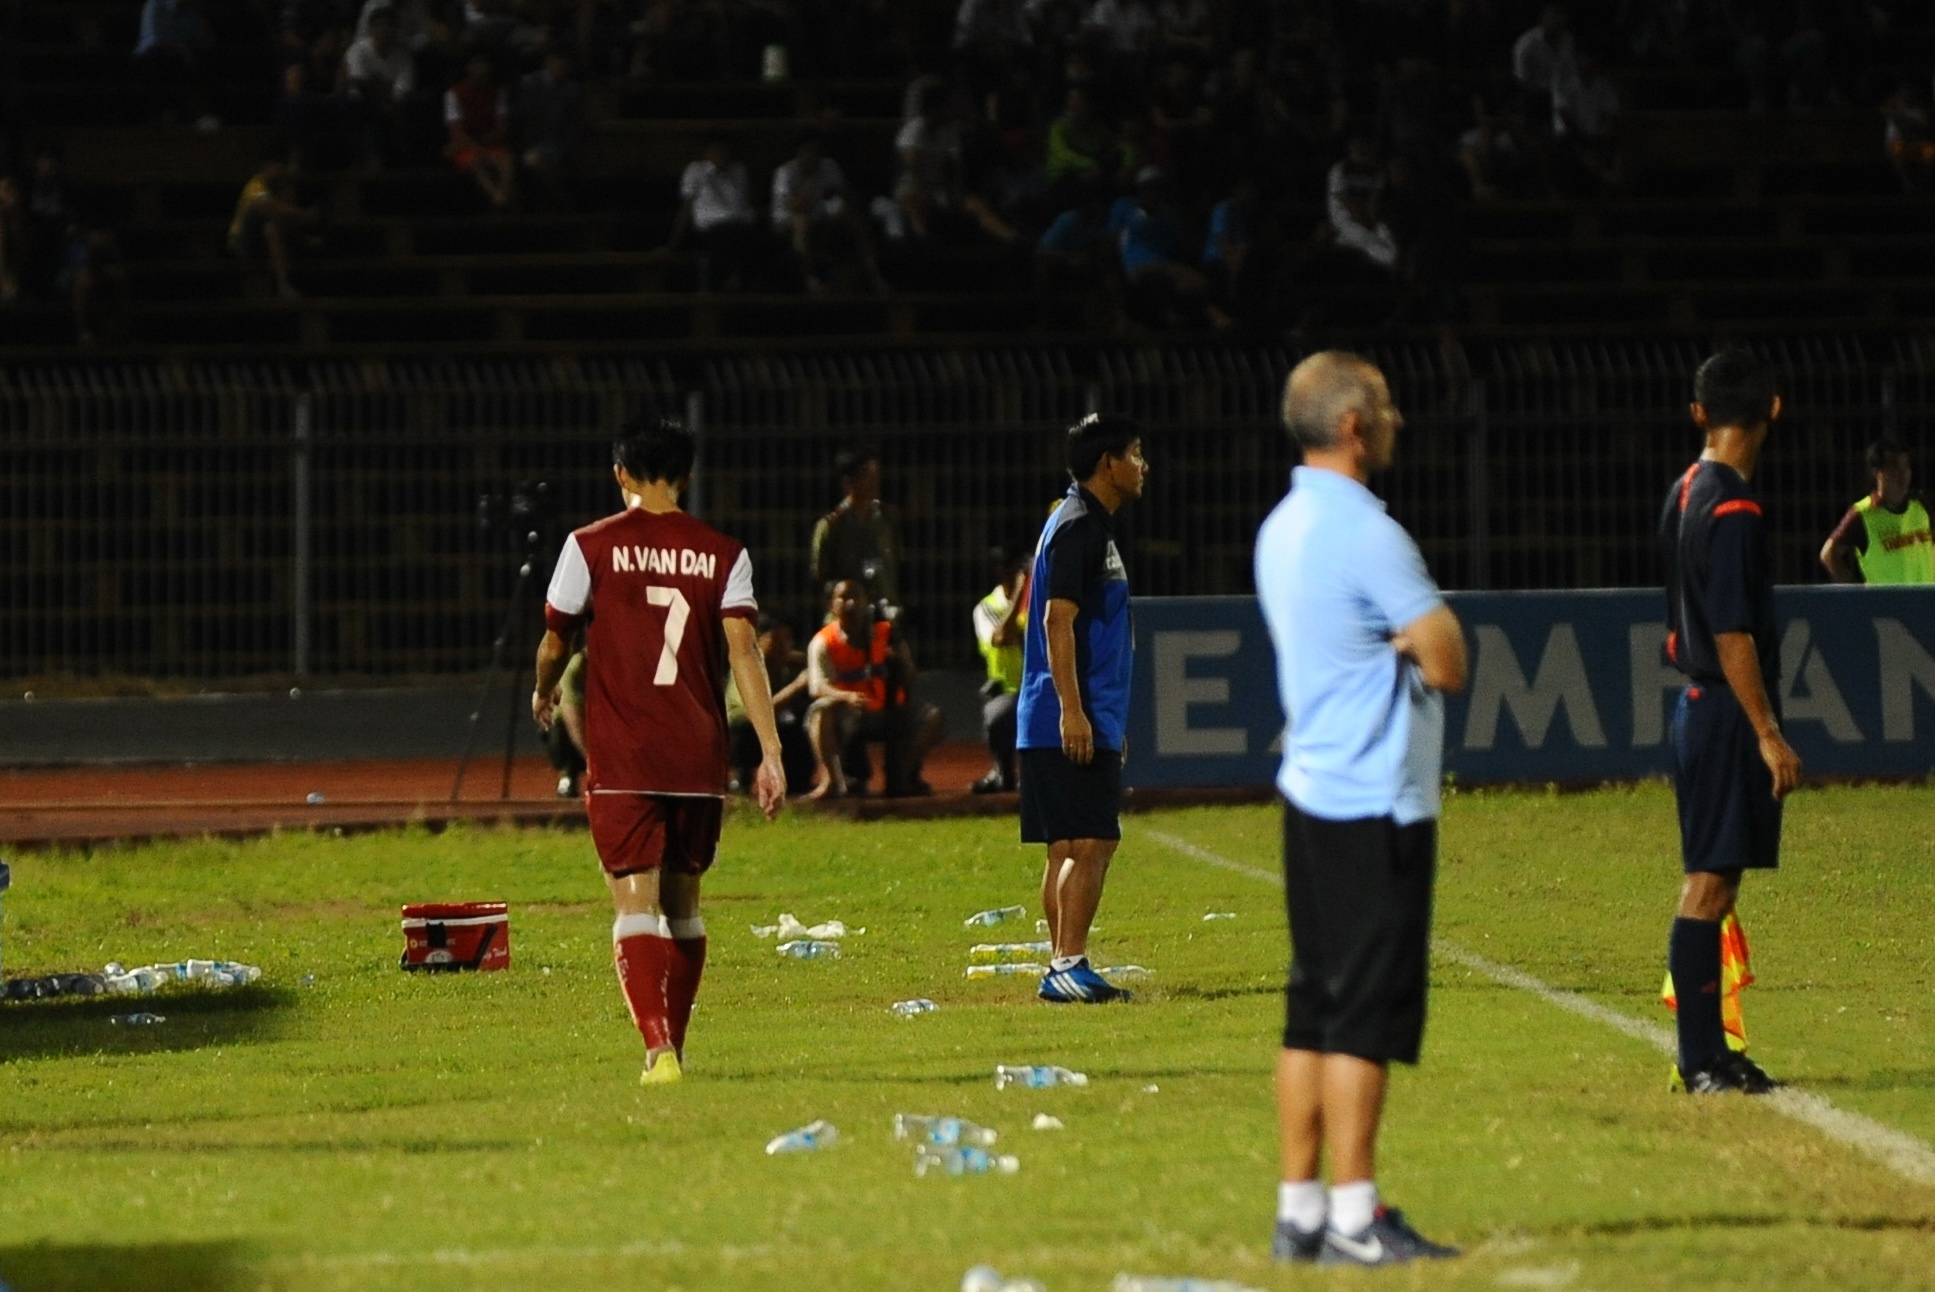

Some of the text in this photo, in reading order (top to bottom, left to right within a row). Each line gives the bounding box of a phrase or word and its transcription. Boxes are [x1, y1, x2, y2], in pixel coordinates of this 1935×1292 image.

[612, 545, 716, 579] N.VAN DAI
[646, 586, 691, 686] 7
